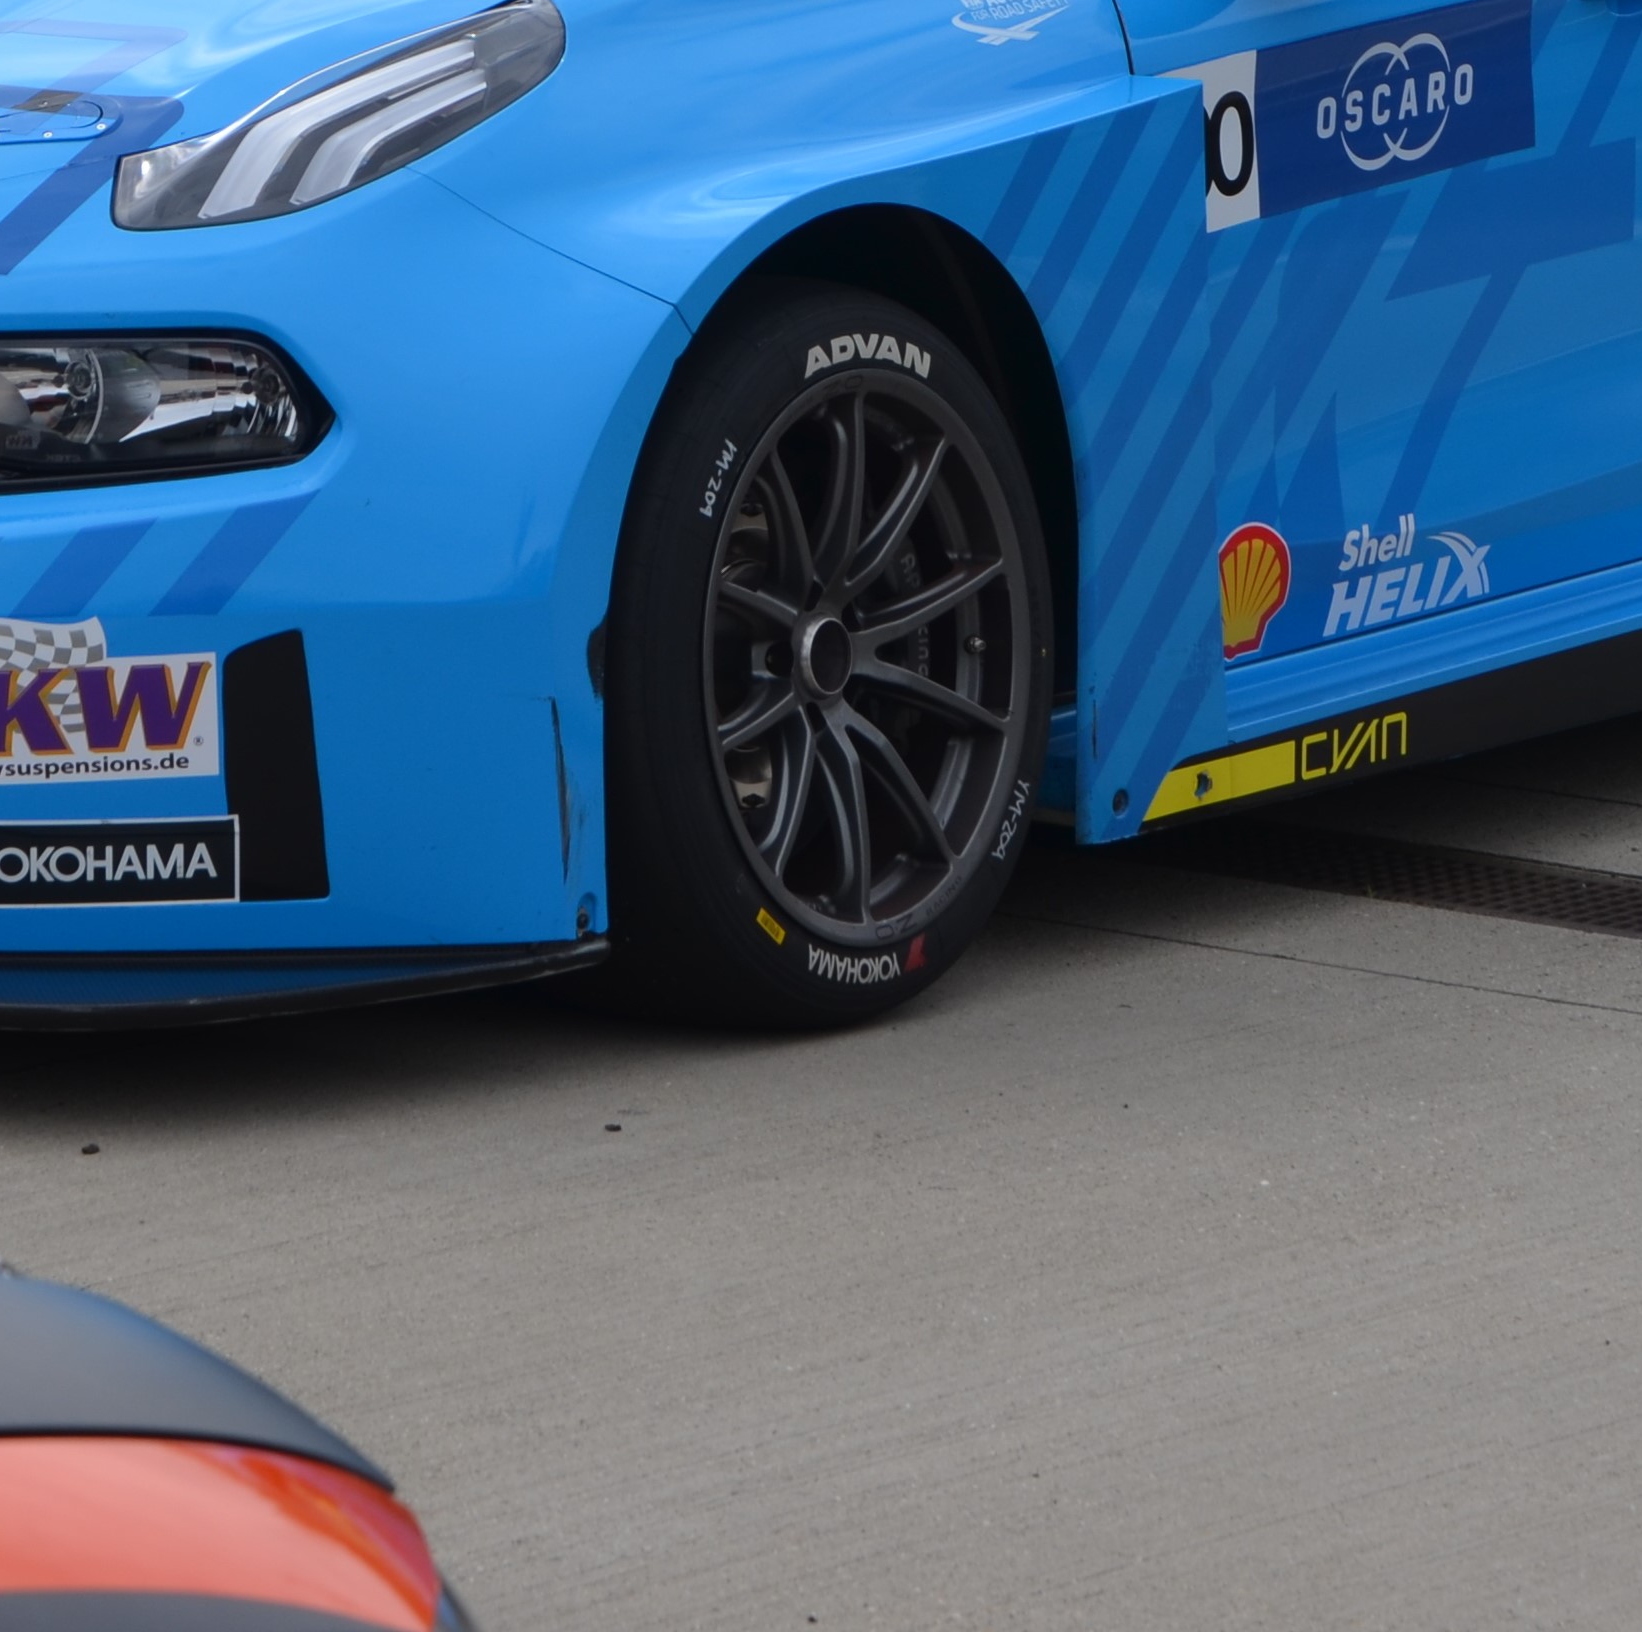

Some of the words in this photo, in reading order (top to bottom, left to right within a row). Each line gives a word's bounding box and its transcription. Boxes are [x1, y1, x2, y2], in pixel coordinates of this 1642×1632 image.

[989, 2, 1025, 20] ROAD
[1315, 62, 1474, 140] OSCARO
[803, 333, 932, 379] ADVAN
[1337, 512, 1415, 572] Shell
[1322, 530, 1491, 639] HELIX
[807, 942, 901, 985] YOKOHAMA
